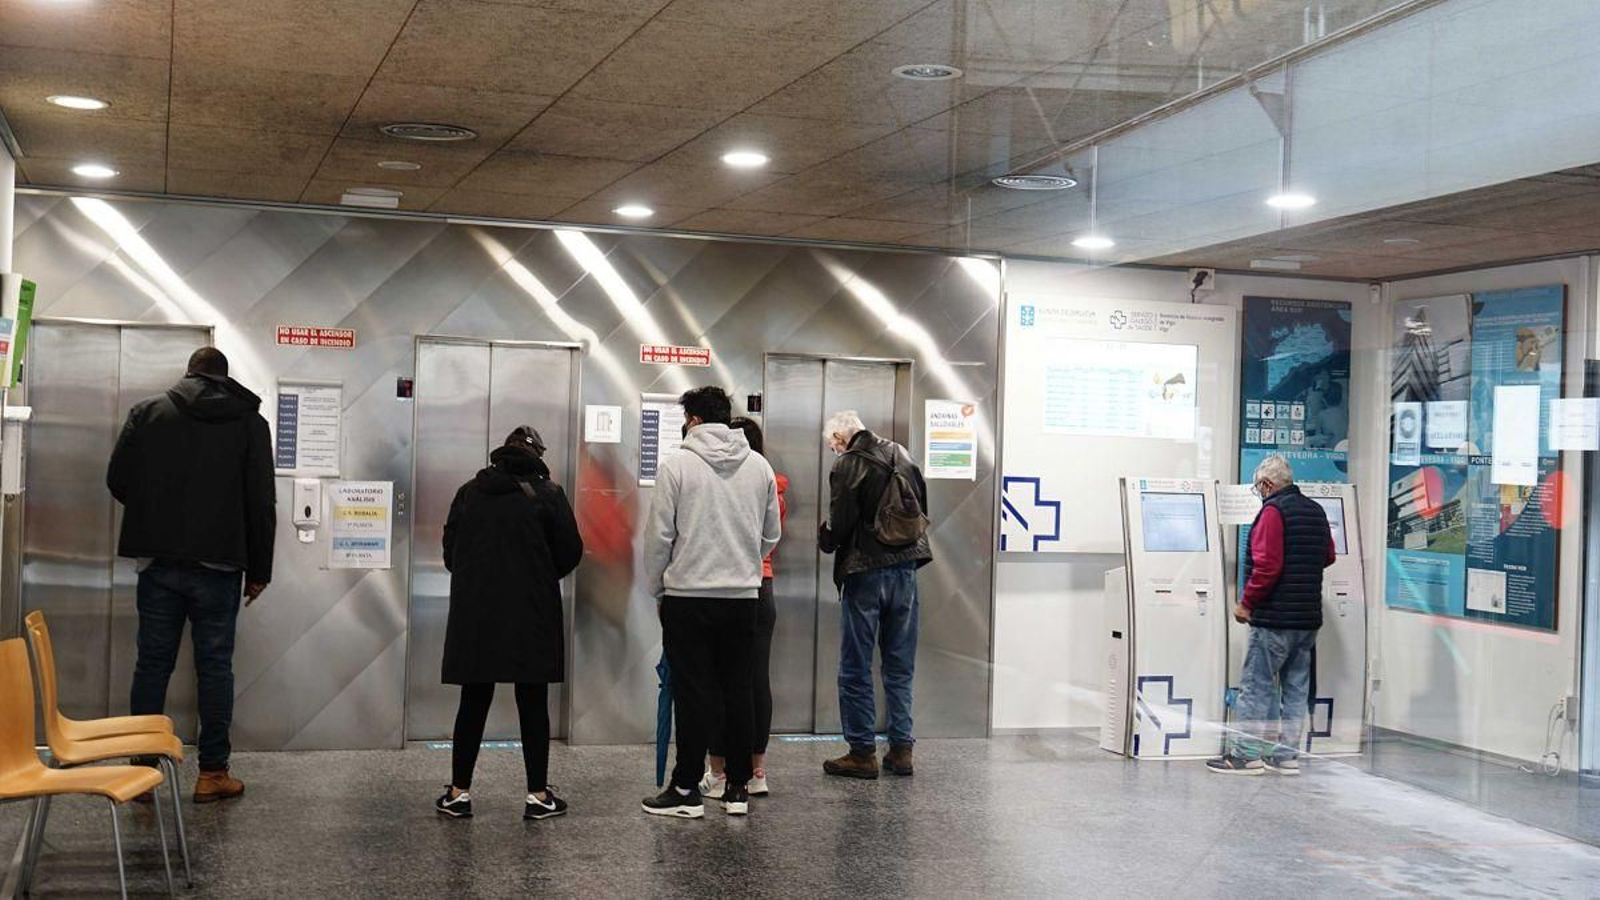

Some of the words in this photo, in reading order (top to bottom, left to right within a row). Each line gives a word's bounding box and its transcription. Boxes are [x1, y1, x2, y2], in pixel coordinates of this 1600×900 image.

[280, 327, 290, 335] NO
[291, 328, 309, 336] USAR
[320, 329, 352, 338] ASCENSOR
[320, 338, 351, 347] INCENDIO
[654, 346, 669, 354] USAR
[680, 348, 708, 356] ASCENSOR
[653, 354, 669, 362] CASO
[680, 356, 707, 364] INCENDIO
[1266, 450, 1318, 459] PONTEVEDRA
[1326, 452, 1346, 460] VIGO
[1471, 456, 1492, 464] PONTE
